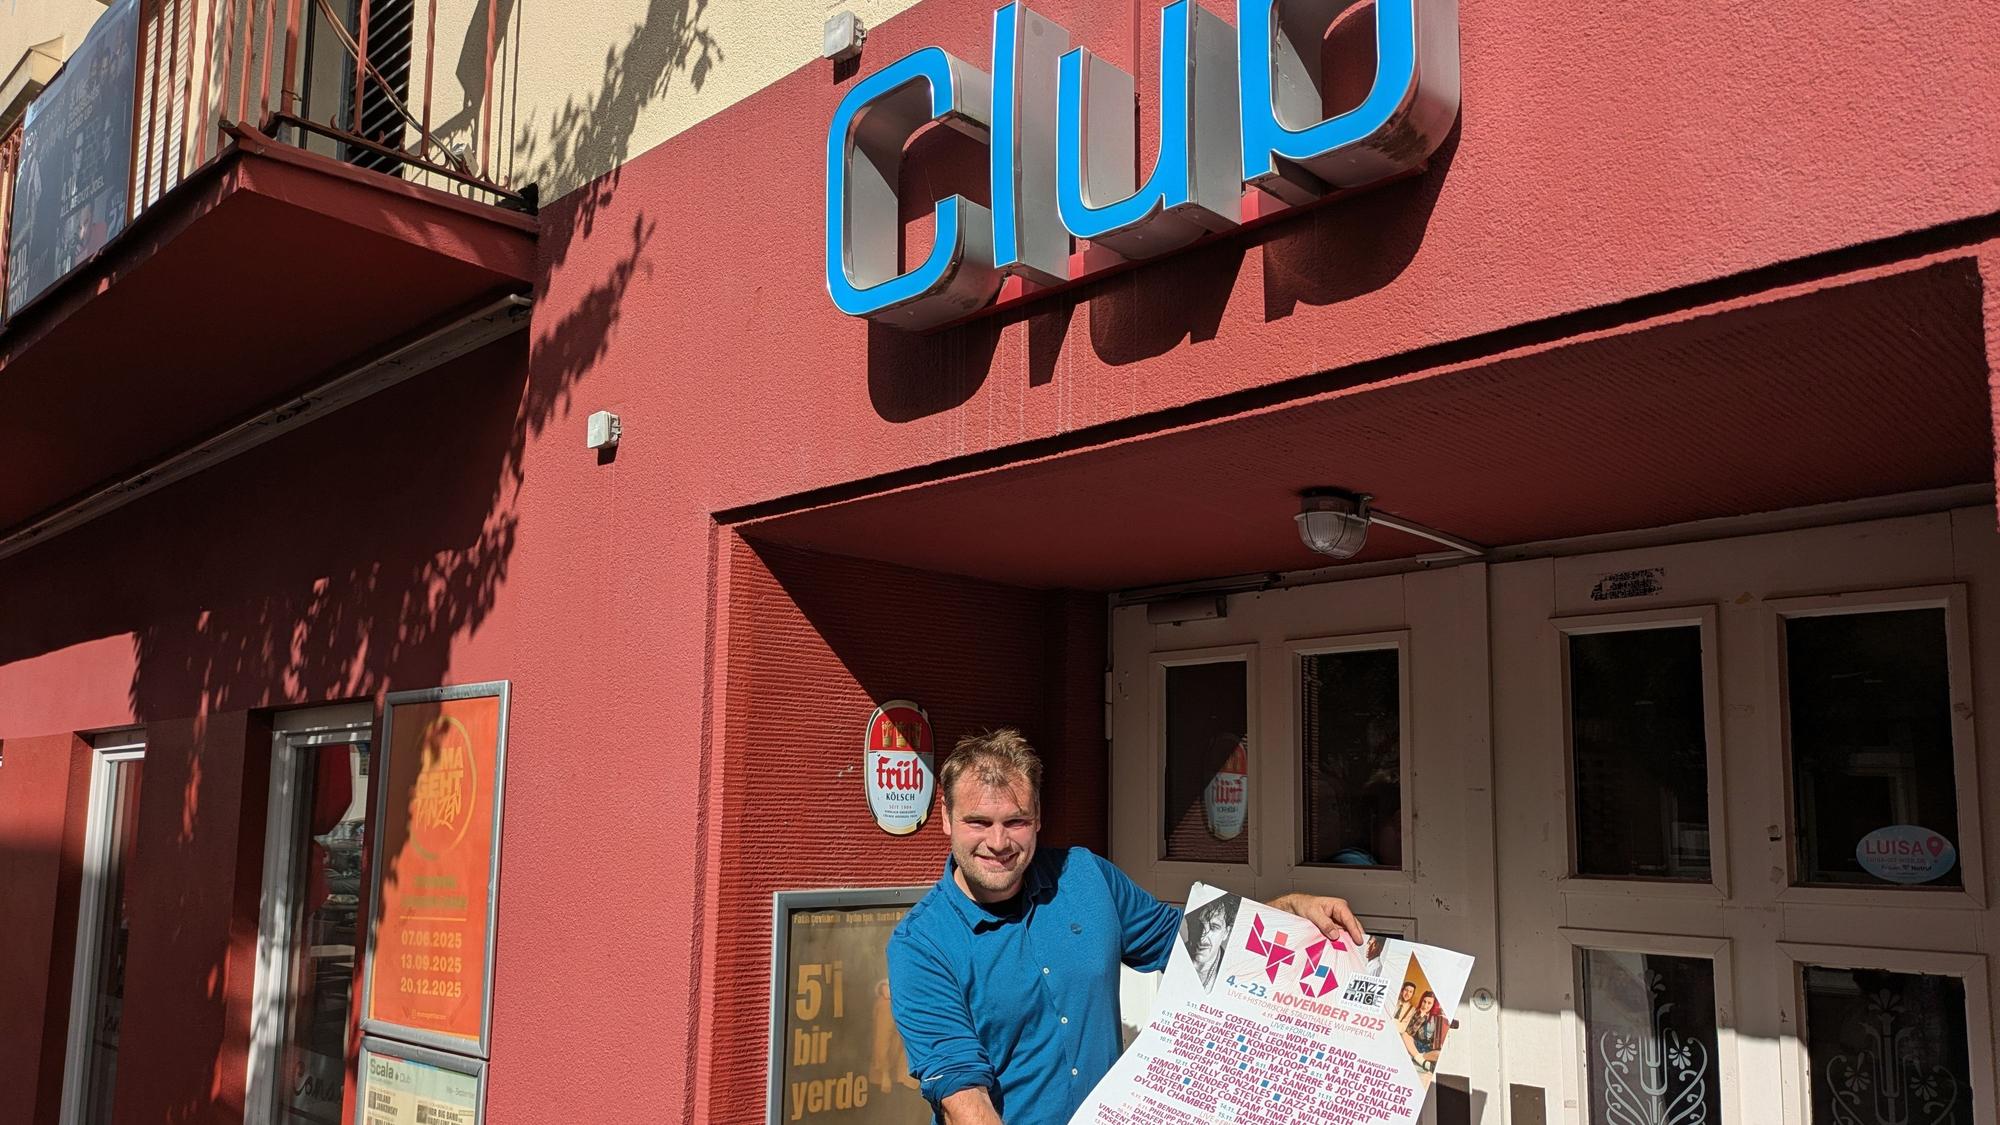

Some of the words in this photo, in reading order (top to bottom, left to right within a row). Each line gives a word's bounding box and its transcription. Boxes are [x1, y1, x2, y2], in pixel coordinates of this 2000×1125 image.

[826, 0, 1420, 320] Club
[416, 770, 465, 799] GEHT
[876, 756, 924, 795] früh
[886, 791, 915, 801] KÖLSCH
[1865, 839, 1924, 855] LUISA
[400, 976, 462, 999] 20.12.2025
[1349, 979, 1387, 996] JAZZ
[1272, 990, 1349, 1022] NOVEMBER
[1351, 1013, 1385, 1031] 2025
[1274, 1012, 1293, 1024] JON
[1294, 1018, 1331, 1035] BATISTE
[794, 1028, 832, 1067] bir
[1199, 1003, 1223, 1018] ELVIS
[1225, 1013, 1269, 1033] COSTELLO
[1285, 1032, 1308, 1045] WDR
[1309, 1040, 1326, 1051] BIG
[1328, 1046, 1357, 1061] BAND
[1357, 1058, 1386, 1070] ARRANGED
[1222, 1021, 1263, 1040] MICHAEL
[1265, 1035, 1314, 1056] LEONHART
[1325, 1054, 1355, 1069] ALMA
[1357, 1064, 1390, 1080] NAIDU
[1333, 1022, 1376, 1040] WUPPERTAL
[370, 1059, 394, 1079] Scala
[1149, 1020, 1178, 1036] ALUNE
[1179, 1032, 1206, 1046] WADE
[1215, 1044, 1254, 1064] HATTLER
[1268, 1063, 1291, 1077] MAX
[1292, 1071, 1323, 1088] HERRE
[1325, 1082, 1333, 1091] &
[1334, 1085, 1354, 1098] JOY
[1356, 1093, 1413, 1118] DENALANE
[1172, 1020, 1203, 1037] CANDY
[1204, 1031, 1238, 1049] DULFER
[1249, 1047, 1277, 1062] DIRTY
[1279, 1057, 1309, 1073] LOOPS
[1324, 1072, 1367, 1092] MARCUS
[1369, 1087, 1407, 1105] MILLER
[1174, 1012, 1206, 1029] KEZIAH
[1207, 1024, 1235, 1039] JONES
[1246, 1037, 1298, 1060] KOKOROKO
[1308, 1058, 1330, 1070] RAH
[1331, 1066, 1340, 1074] &
[1342, 1068, 1361, 1081] THE
[1365, 1075, 1413, 1097] RUFFCATS
[791, 1071, 869, 1121] yerde
[1134, 1075, 1165, 1093] DYLAN
[1166, 1088, 1216, 1113] CHAMBERS
[1146, 1072, 1184, 1091] TORSTEN
[1185, 1087, 1218, 1104] GOODS
[1151, 1056, 1180, 1072] SIMON
[1181, 1067, 1230, 1091] OSLENDER,
[1233, 1087, 1262, 1104] STEVE
[1263, 1099, 1294, 1117] GADD,
[1173, 1038, 1203, 1054] MARIO
[1204, 1049, 1237, 1067] BIONDI
[1248, 1065, 1280, 1082] MYLES
[1281, 1077, 1316, 1094] SANKO
[1334, 1095, 1391, 1120] CHRISTONE
[1189, 1061, 1220, 1078] CHILLY
[1221, 1073, 1271, 1098] GONZALES
[1281, 1096, 1305, 1110] JAZZ
[1307, 1105, 1354, 1125] SABBATH
[1220, 1064, 1259, 1084] INGRAM
[1270, 1082, 1316, 1104] ANDREAS
[1318, 1099, 1371, 1124] KÜMMERT
[1099, 1102, 1131, 1124] VINCENT
[1134, 1107, 1164, 1124] DHAFER
[1143, 1096, 1156, 1106] TIM
[1157, 1102, 1191, 1120] BENDZKO
[1149, 1107, 1176, 1122] PHILIPP
[1191, 1080, 1216, 1095] BILLY
[1265, 1109, 1288, 1123] TIME
